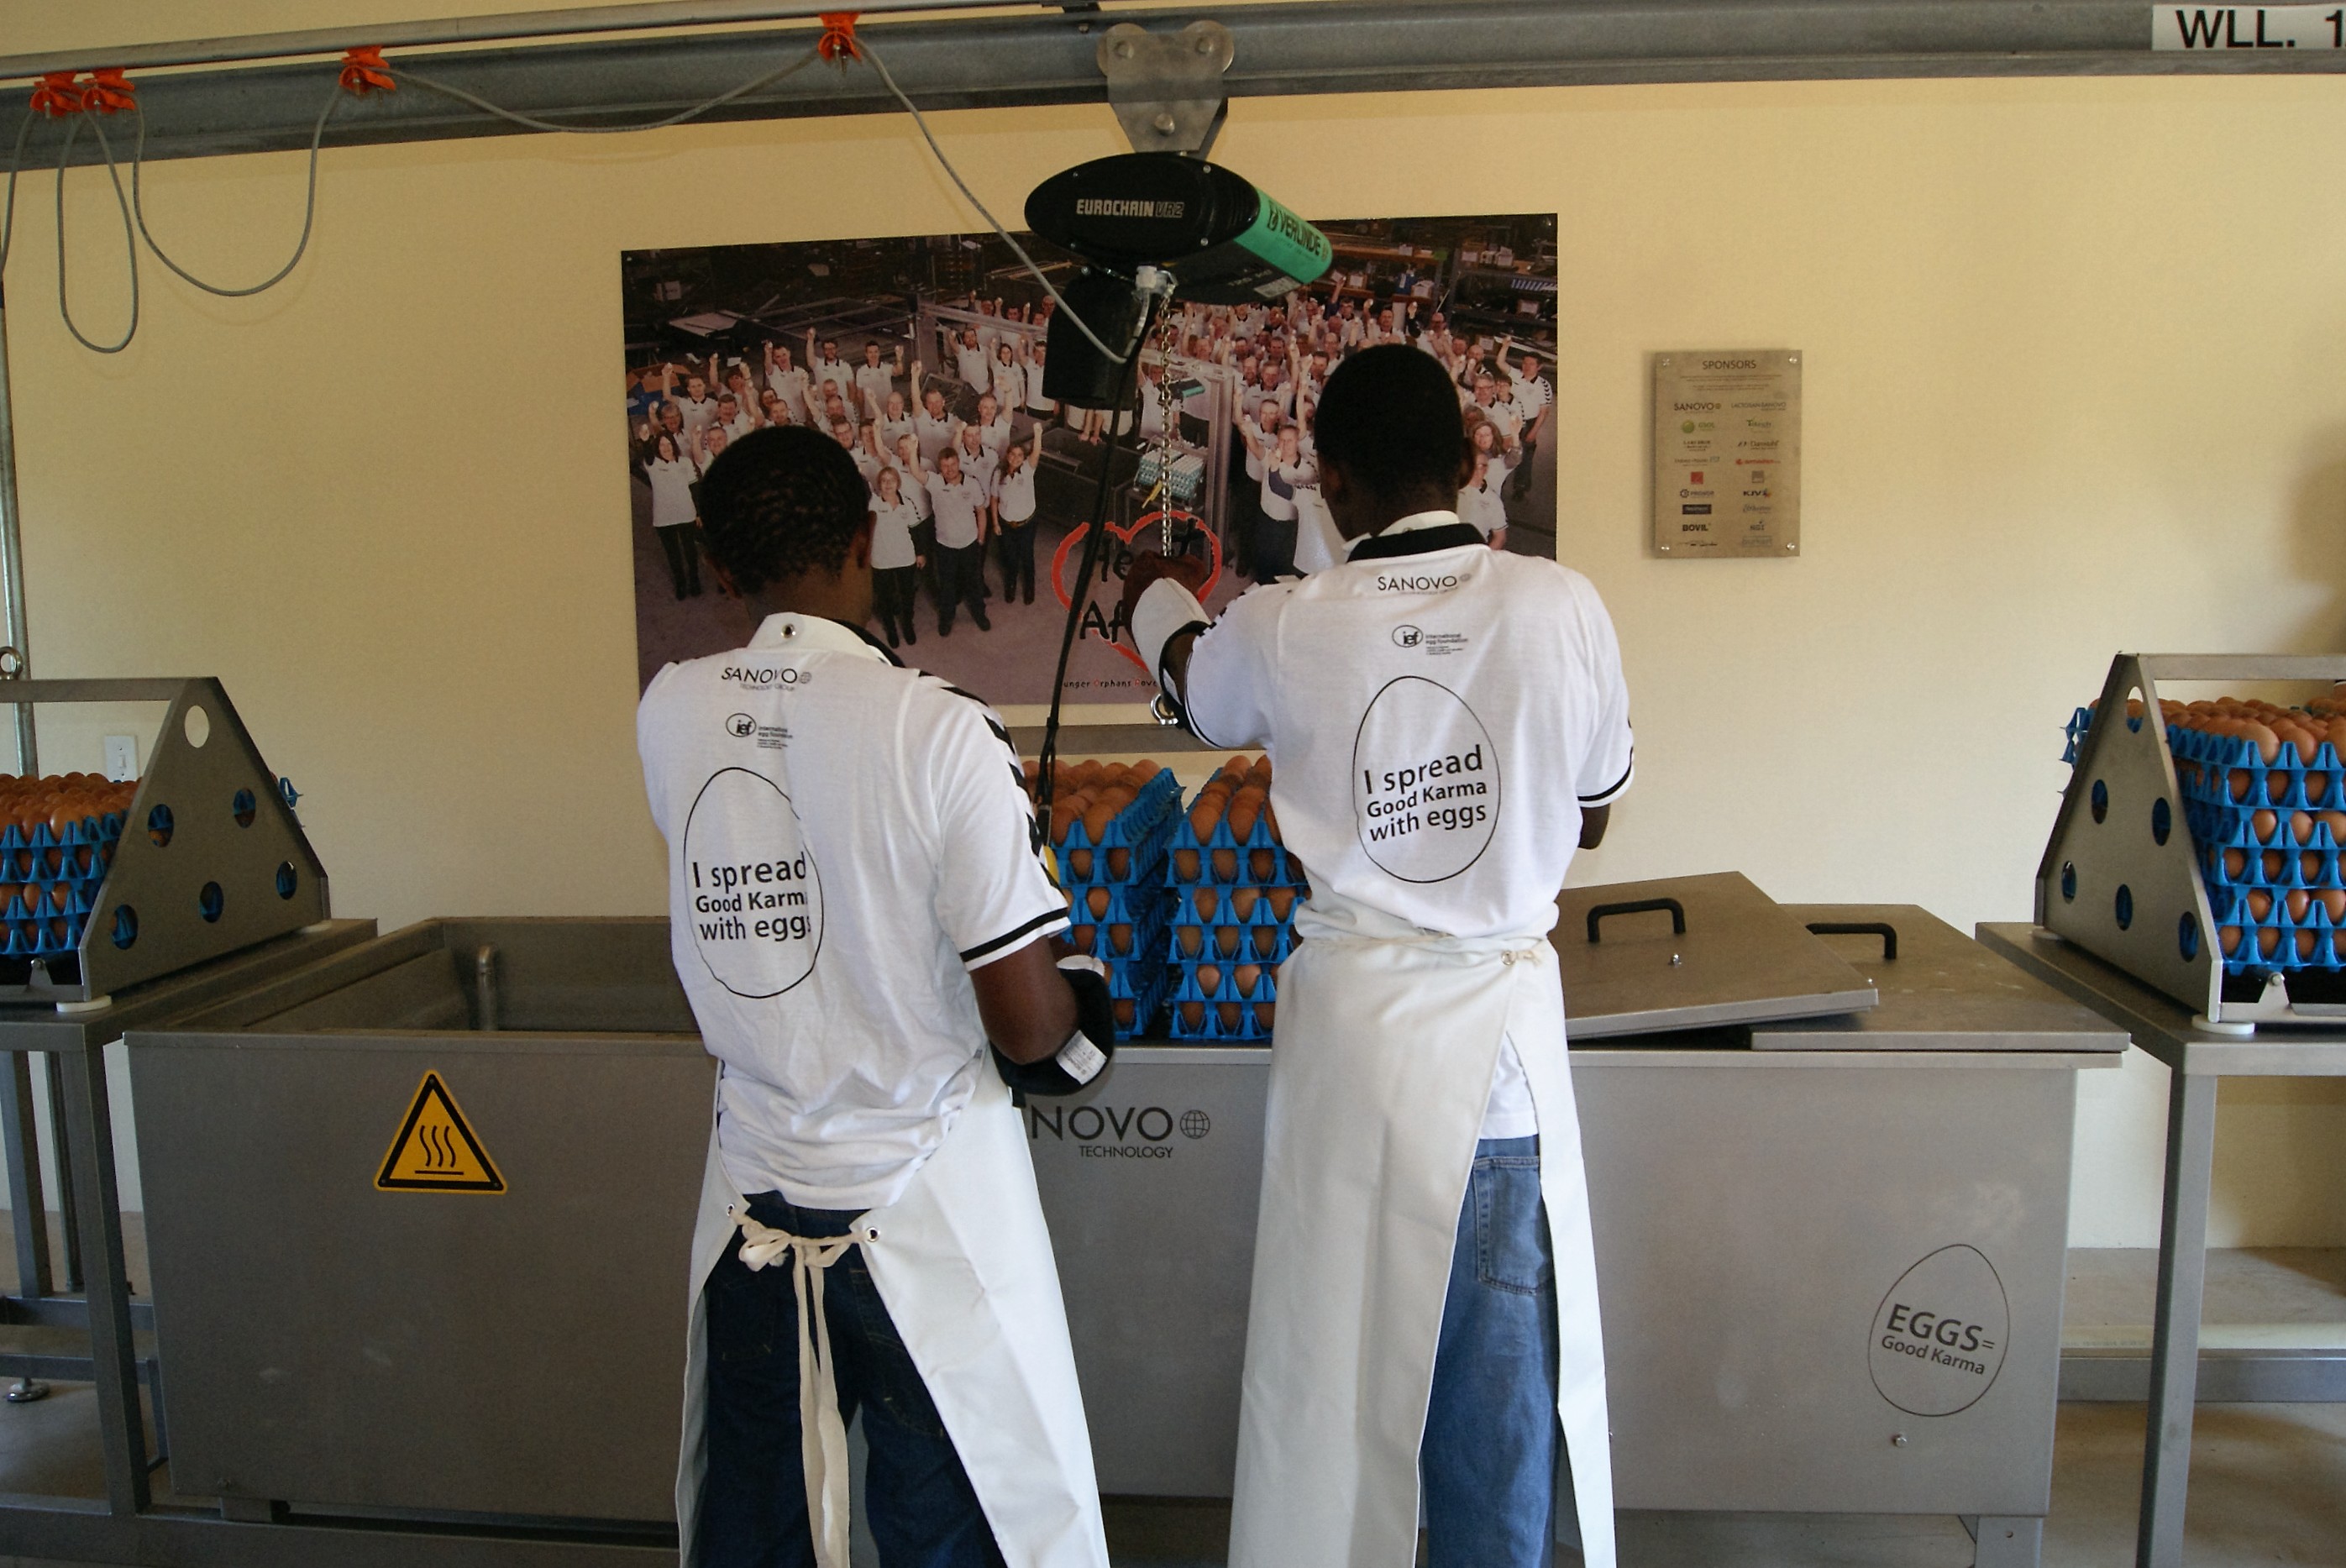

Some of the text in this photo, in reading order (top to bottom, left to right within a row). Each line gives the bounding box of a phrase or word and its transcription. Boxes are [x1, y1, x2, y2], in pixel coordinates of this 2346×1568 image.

[2175, 9, 2296, 49] WLL.
[1279, 208, 1321, 256] VERLINDE
[1702, 359, 1757, 370] SPONSORS
[1673, 401, 1714, 412] SANOVO
[1378, 574, 1458, 591] SANOVO
[721, 667, 798, 684] SANOVO
[1063, 678, 1157, 690] unger Orphans Pove
[1364, 743, 1483, 795] I spread
[1367, 781, 1488, 818] Good Karma
[1369, 804, 1487, 842] with eggs
[692, 851, 806, 894] I spread
[695, 890, 808, 913] Good Karm
[699, 915, 747, 941] with
[1031, 1104, 1173, 1142] NOVO
[1079, 1145, 1173, 1159] TECHNOLOGY
[1881, 1335, 1986, 1376] Good Karma
